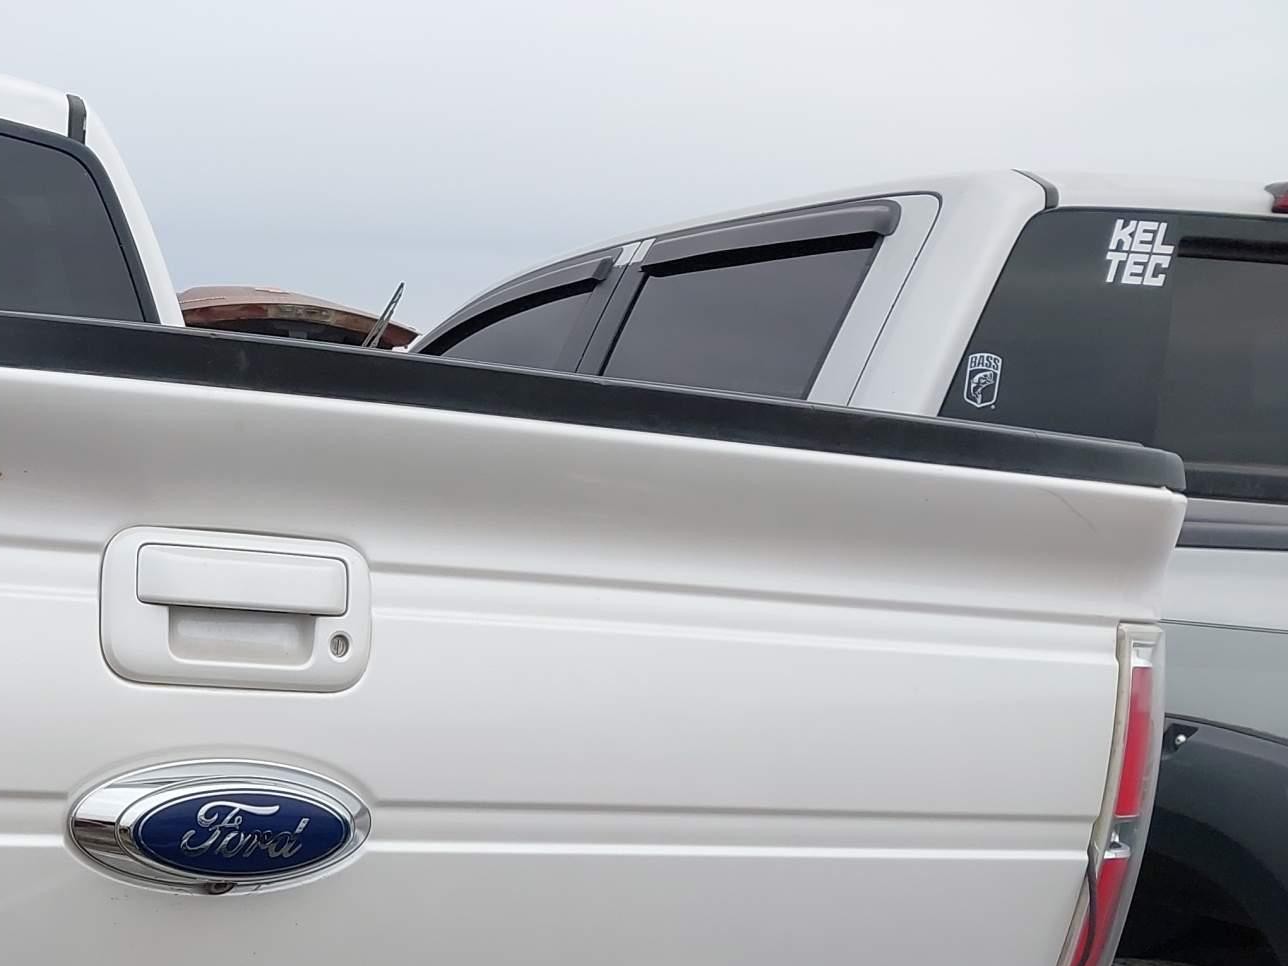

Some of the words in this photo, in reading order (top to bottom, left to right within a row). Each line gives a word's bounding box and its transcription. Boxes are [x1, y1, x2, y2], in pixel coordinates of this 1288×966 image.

[1108, 218, 1174, 254] KEL
[1106, 252, 1171, 287] TEC
[970, 354, 1000, 371] BASS
[180, 800, 310, 858] Ford
